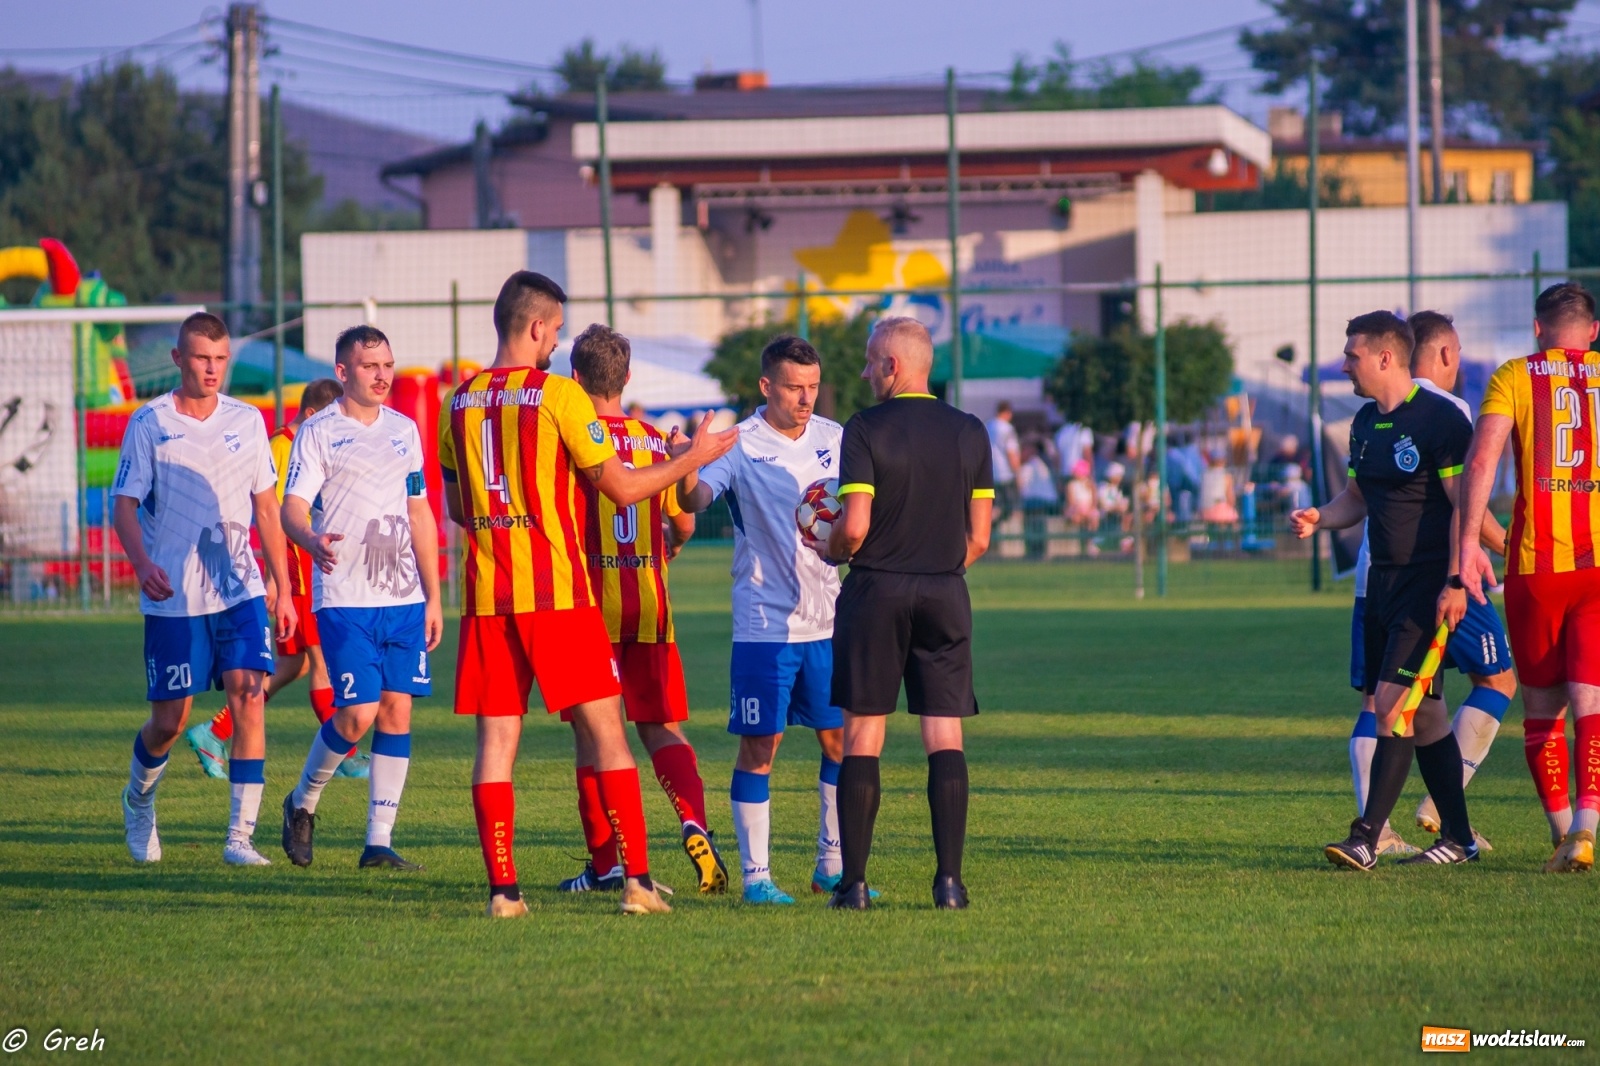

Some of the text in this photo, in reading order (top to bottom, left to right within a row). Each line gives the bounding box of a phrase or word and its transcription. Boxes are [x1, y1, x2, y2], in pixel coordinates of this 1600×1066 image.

[1527, 360, 1600, 379] PŁOMIEŃ POŁ
[166, 662, 192, 691] 20
[340, 672, 358, 700] 2
[741, 697, 760, 725] 18
[1544, 736, 1562, 792] OŁOMIA
[1587, 735, 1600, 792] OŁOMIA
